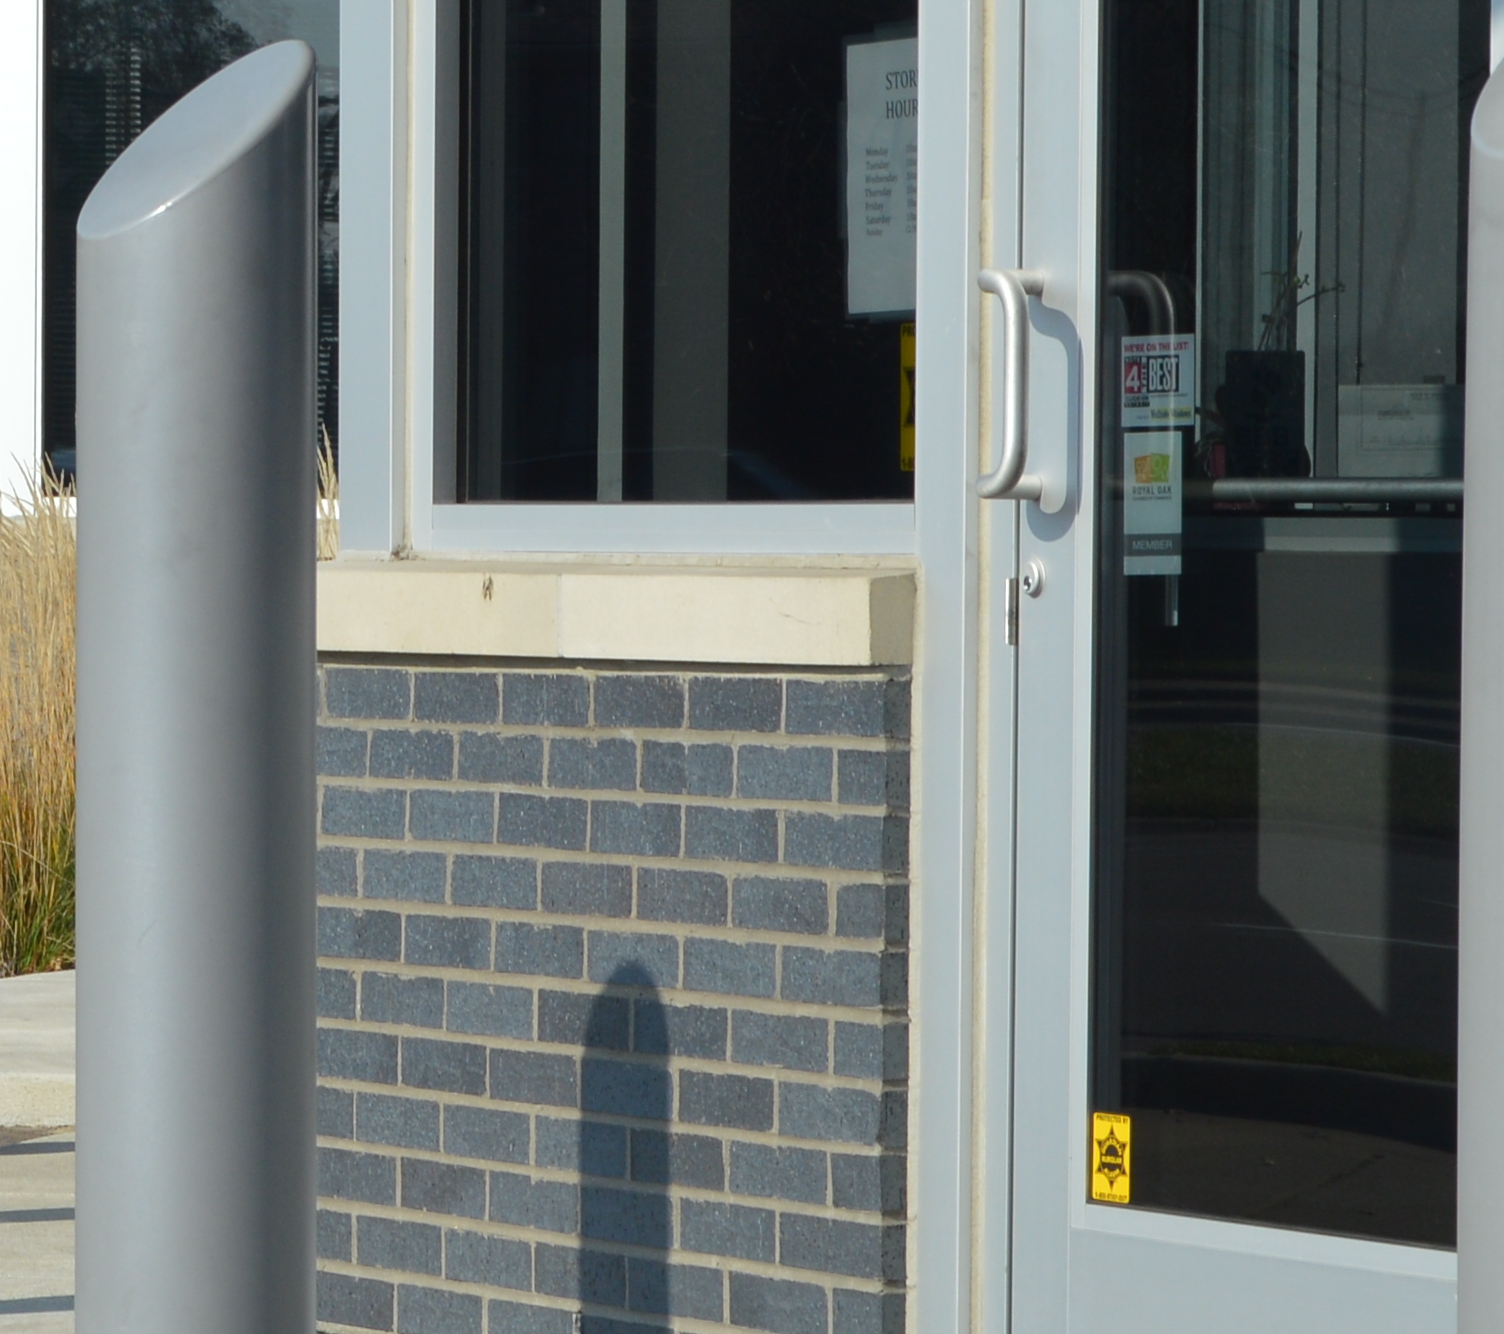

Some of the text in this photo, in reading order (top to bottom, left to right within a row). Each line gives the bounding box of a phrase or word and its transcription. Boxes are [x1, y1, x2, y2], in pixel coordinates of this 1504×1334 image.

[885, 69, 918, 91] STOR
[1146, 342, 1157, 352] ON
[1126, 365, 1140, 392] 4
[1149, 357, 1178, 391] BEST
[1132, 485, 1173, 496] ROYAL OAK
[1132, 539, 1173, 550] MEMBER
